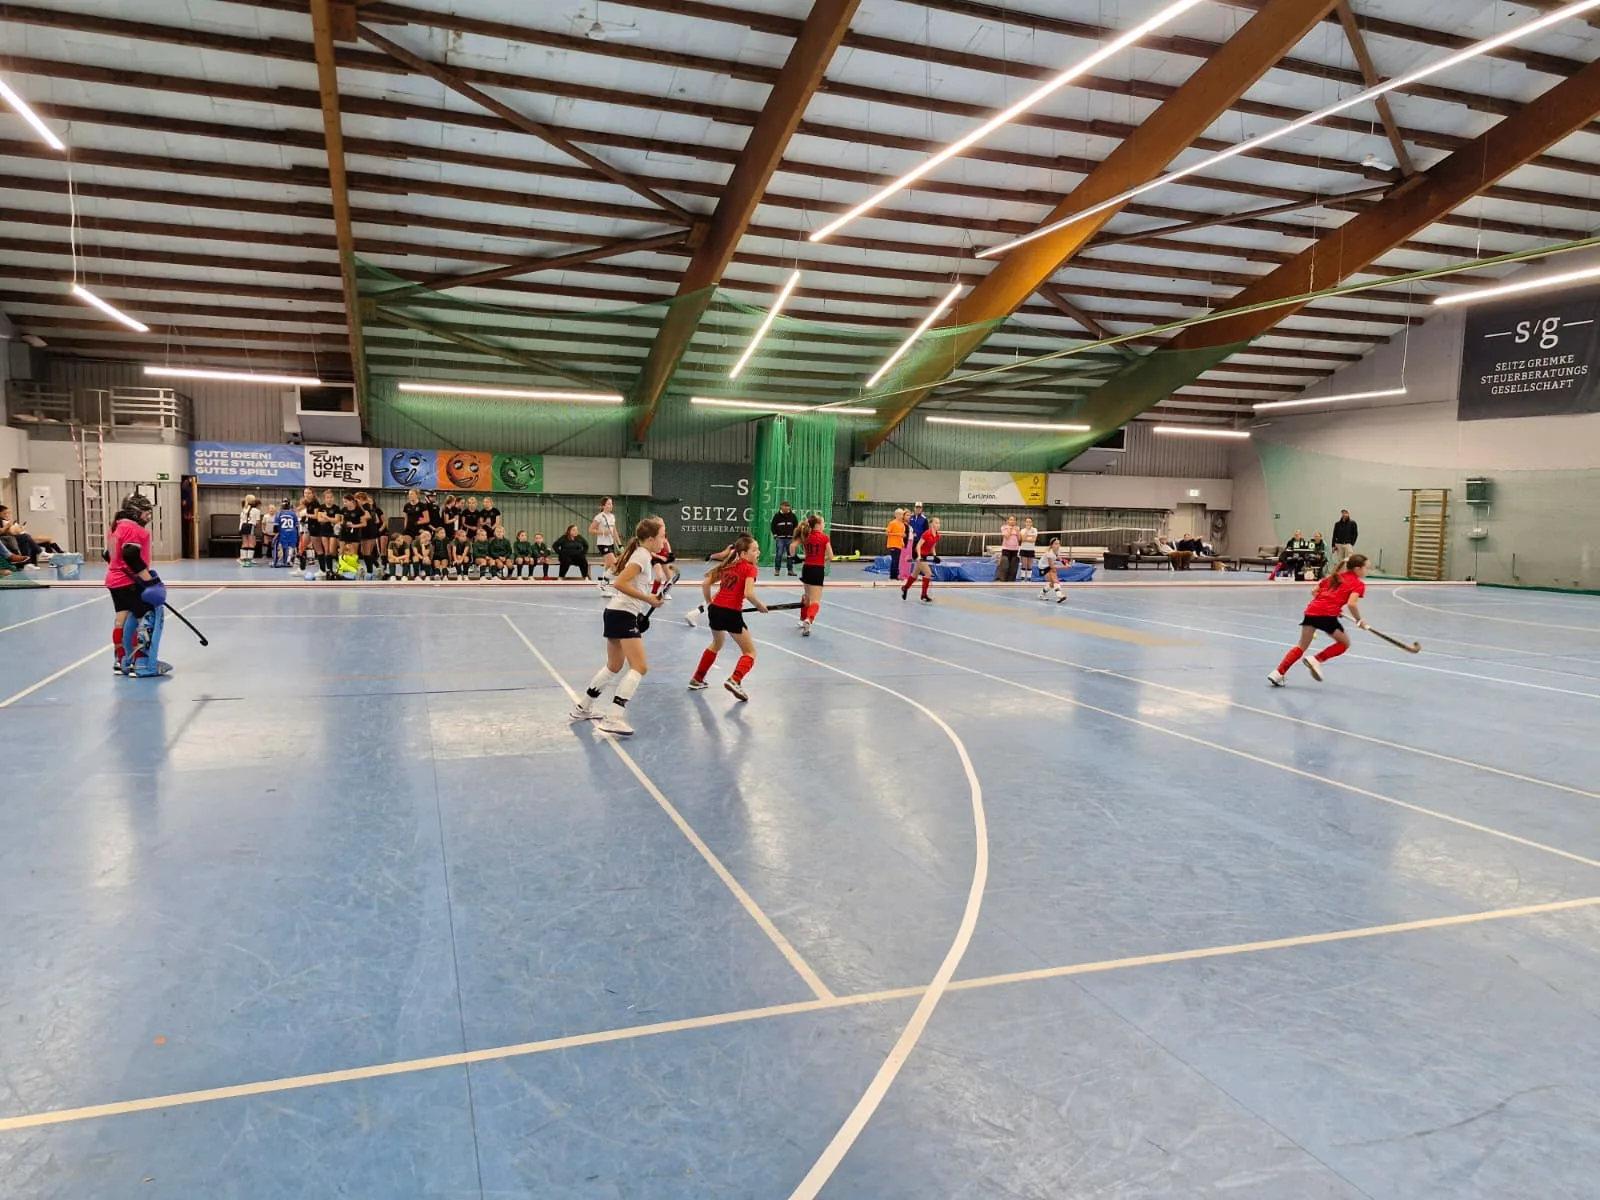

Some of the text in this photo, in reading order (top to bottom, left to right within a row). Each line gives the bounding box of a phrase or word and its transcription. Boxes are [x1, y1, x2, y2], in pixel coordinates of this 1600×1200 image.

[1495, 354, 1574, 372] SEITZ GREMKE
[1480, 365, 1588, 384] STEUERBERATUNGS
[1491, 379, 1574, 395] GESELLSCHAFT
[194, 450, 272, 460] GUTE IDEEN!
[311, 452, 343, 463] ZUM
[194, 458, 302, 469] GUTE STRATEGIE!
[313, 462, 364, 471] HOHEN
[195, 466, 278, 477] GUTES SPIEL!
[313, 471, 355, 480] UFER
[681, 506, 737, 521] SEITZ
[280, 517, 294, 529] 20
